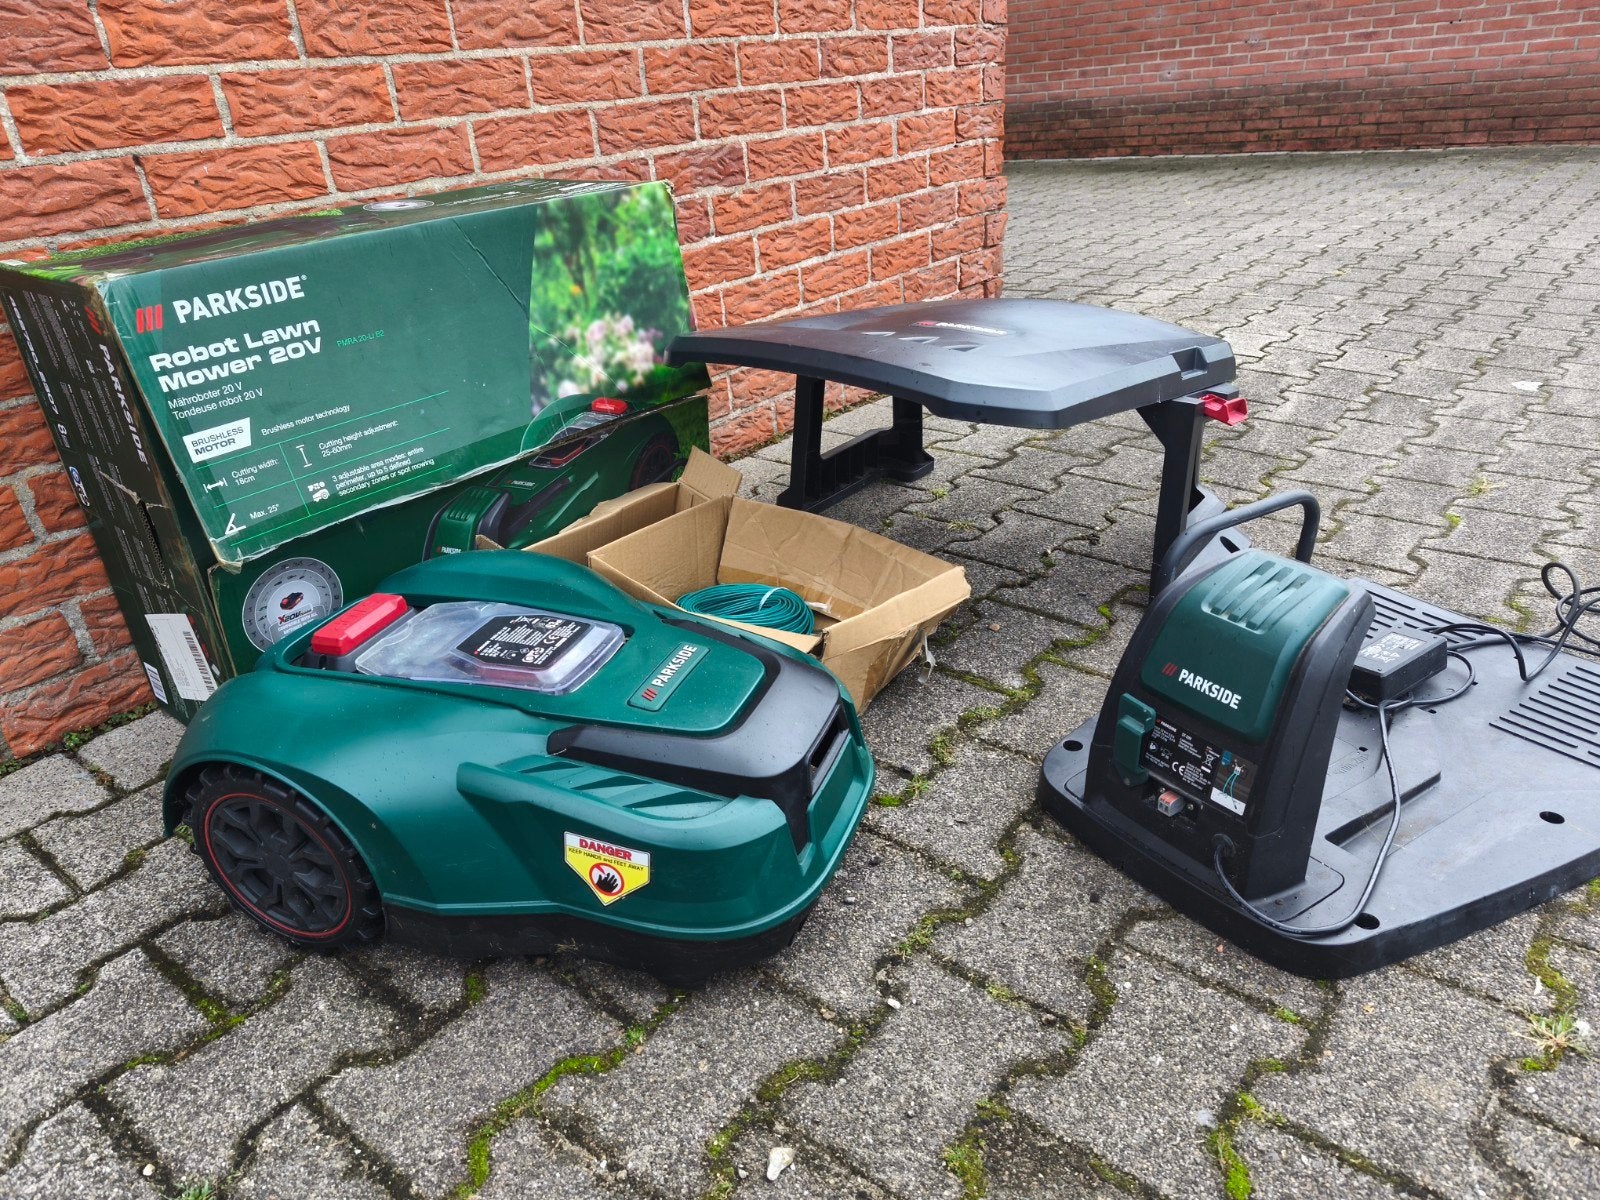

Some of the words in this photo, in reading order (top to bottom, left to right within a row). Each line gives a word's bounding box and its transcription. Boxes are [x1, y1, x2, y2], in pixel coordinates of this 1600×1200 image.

[149, 337, 240, 372] Robot
[243, 319, 320, 349] Lawn
[157, 354, 262, 393] Mower
[268, 336, 321, 365] 20V
[99, 344, 149, 467] PARKSIDE
[168, 388, 221, 410] Mähroboter
[222, 383, 235, 395] 20
[235, 381, 242, 391] V
[172, 402, 218, 420] Tondeuse
[219, 394, 243, 408] robot
[243, 390, 256, 401] 20
[256, 387, 263, 397] V
[261, 420, 295, 436] Brushless
[295, 415, 315, 426] motor
[315, 404, 351, 419] technology
[319, 438, 343, 450] Cutting
[342, 431, 363, 442] height
[363, 420, 398, 436] adjustment:
[191, 426, 244, 447] BRUSHLESS
[194, 438, 236, 456] MOTOR
[231, 464, 258, 479] Cutting
[257, 458, 279, 470] width:
[335, 474, 366, 490] perimeter,
[366, 471, 375, 480] up
[376, 467, 383, 475] to
[389, 458, 411, 471] defined
[338, 465, 370, 481] adjustable
[370, 460, 384, 469] area
[384, 452, 407, 464] modes:
[407, 446, 424, 457] entire
[339, 481, 371, 497] secondary
[371, 474, 390, 485] zones
[397, 466, 411, 477] spot
[411, 458, 435, 471] mowing
[235, 475, 256, 486] 18cm
[249, 509, 268, 520] Max.
[651, 645, 698, 687] PARKSIDE
[1178, 668, 1242, 710] PARKSIDE
[568, 847, 582, 855] KEEP
[583, 851, 602, 861] HANDS
[603, 856, 613, 864] and
[613, 859, 627, 868] FEET
[628, 863, 644, 872] AWAY
[578, 838, 632, 861] DANGER
